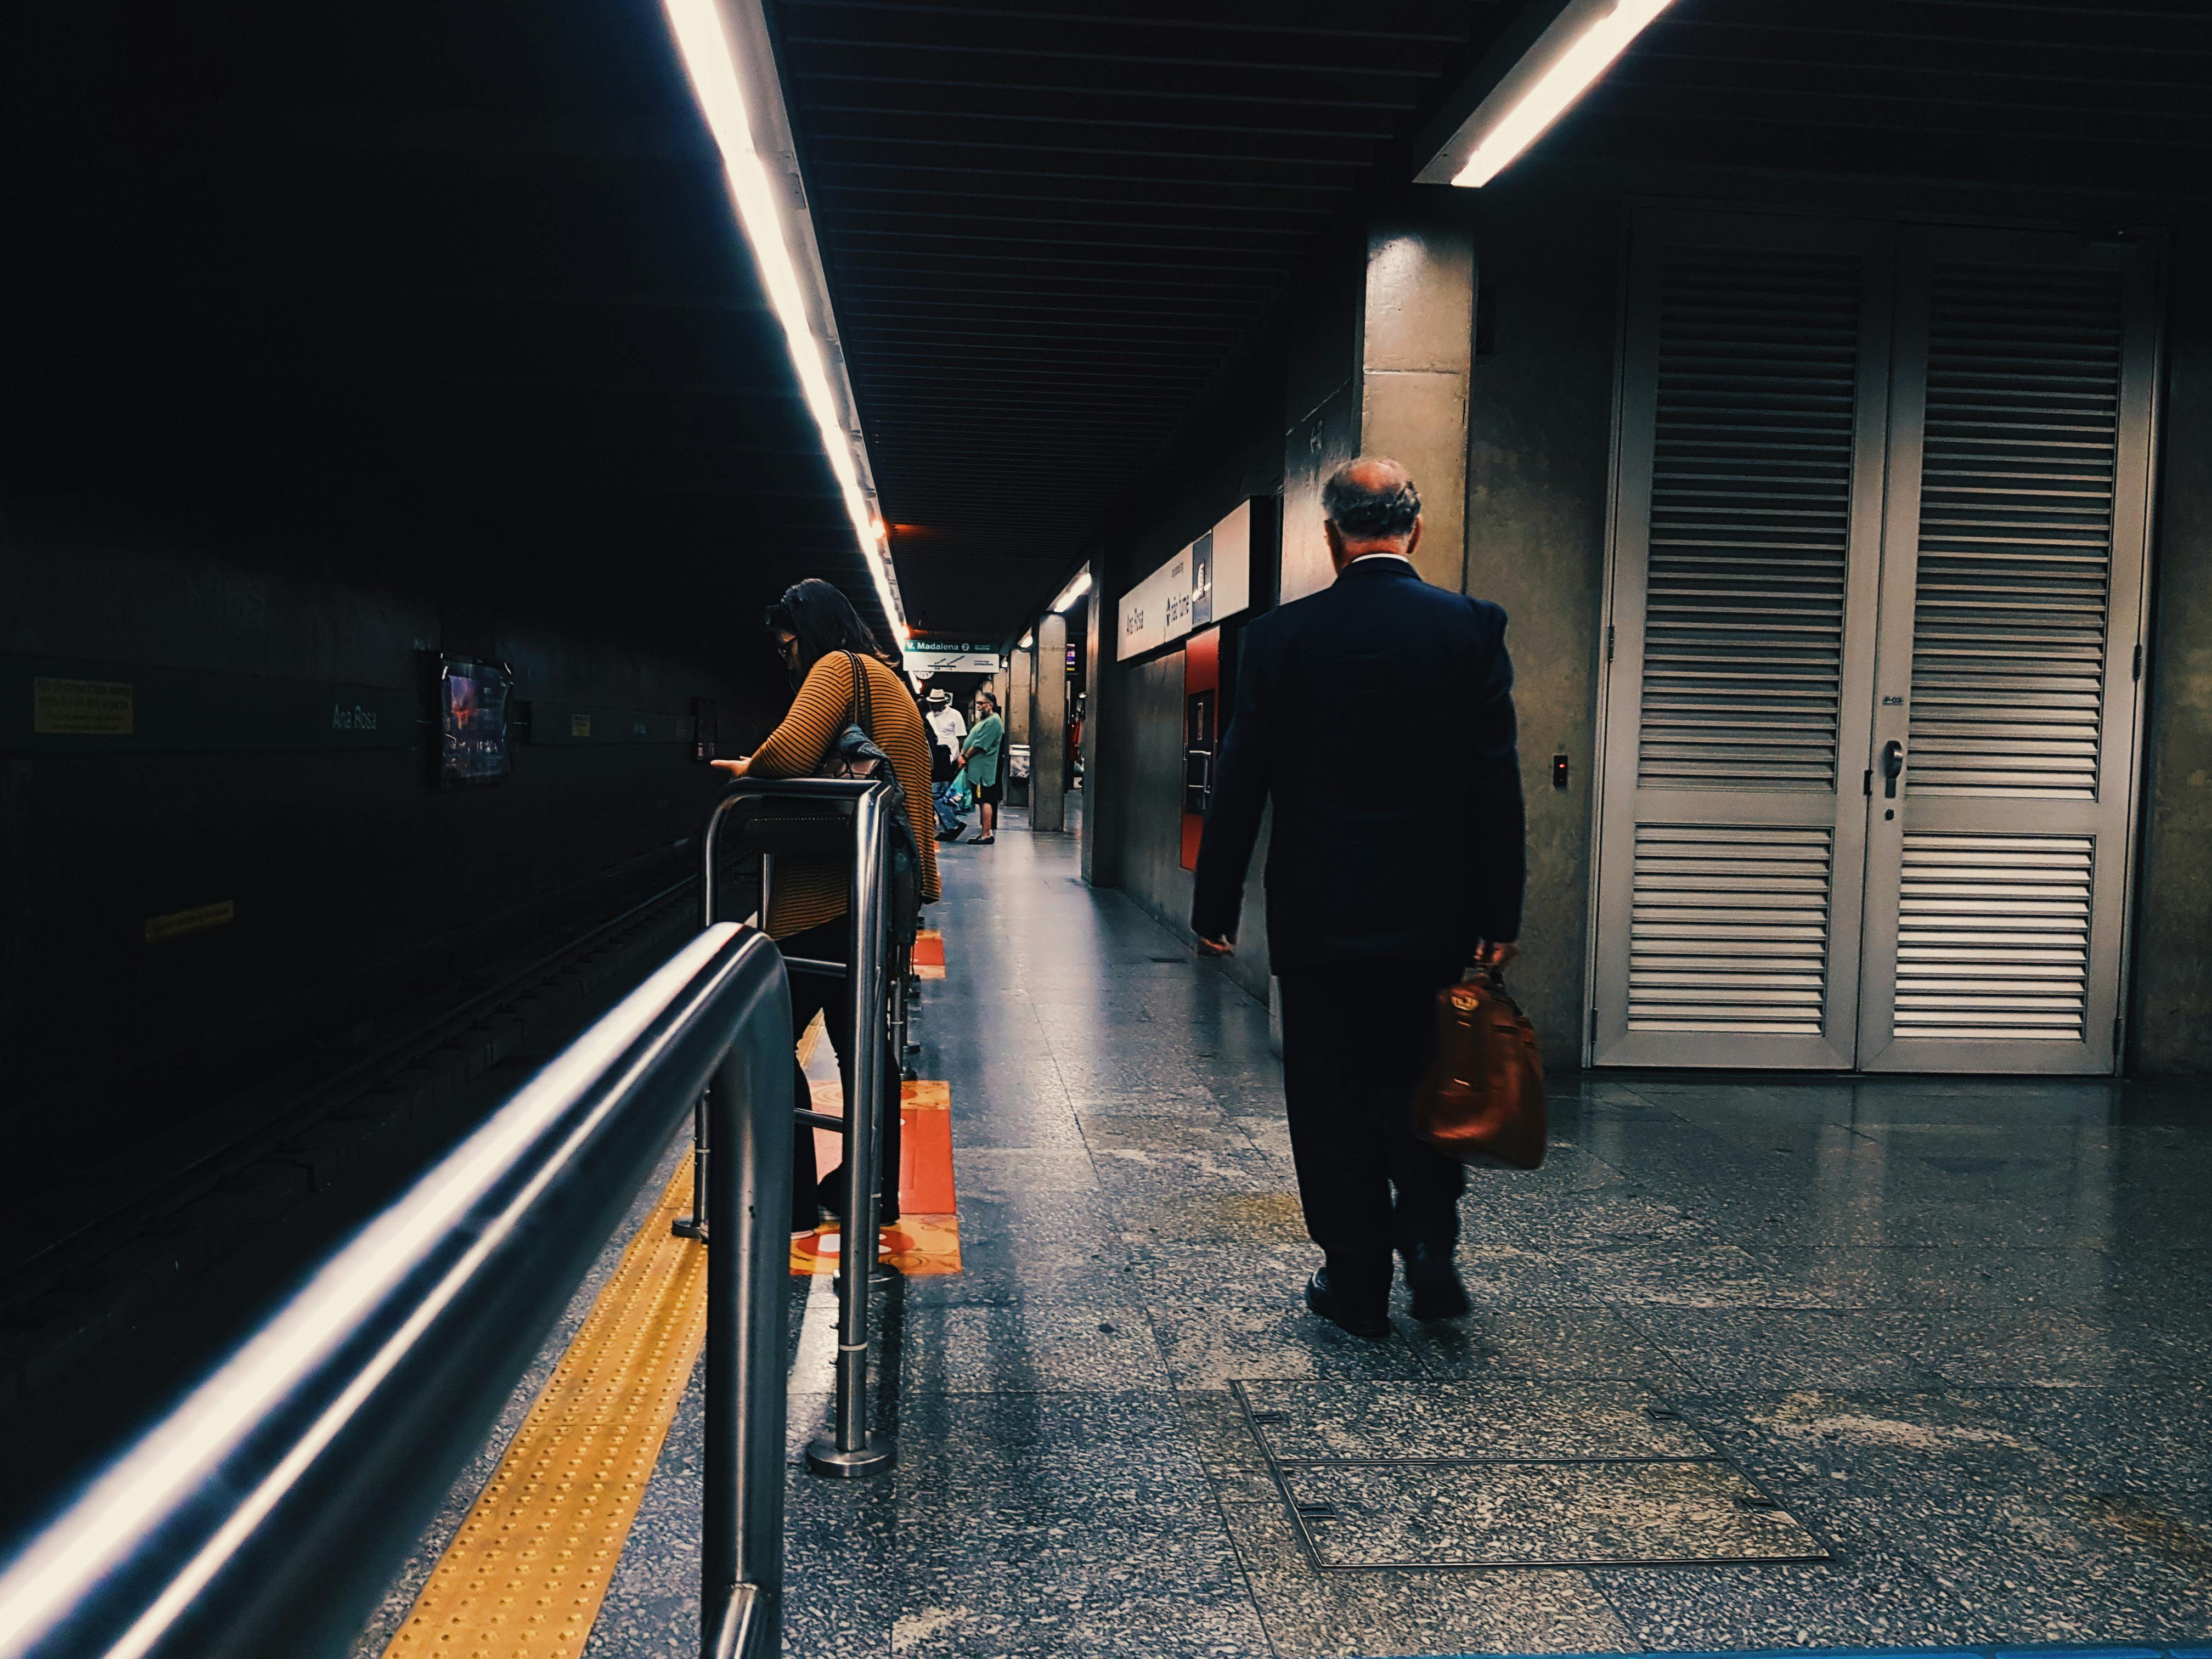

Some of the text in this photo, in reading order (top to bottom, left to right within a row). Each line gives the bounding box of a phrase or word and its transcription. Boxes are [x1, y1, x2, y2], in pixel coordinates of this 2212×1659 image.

[1134, 608, 1143, 631] Rosa
[906, 641, 915, 650] V.
[917, 642, 958, 650] Madalena
[332, 703, 377, 730] Ana Rosa
